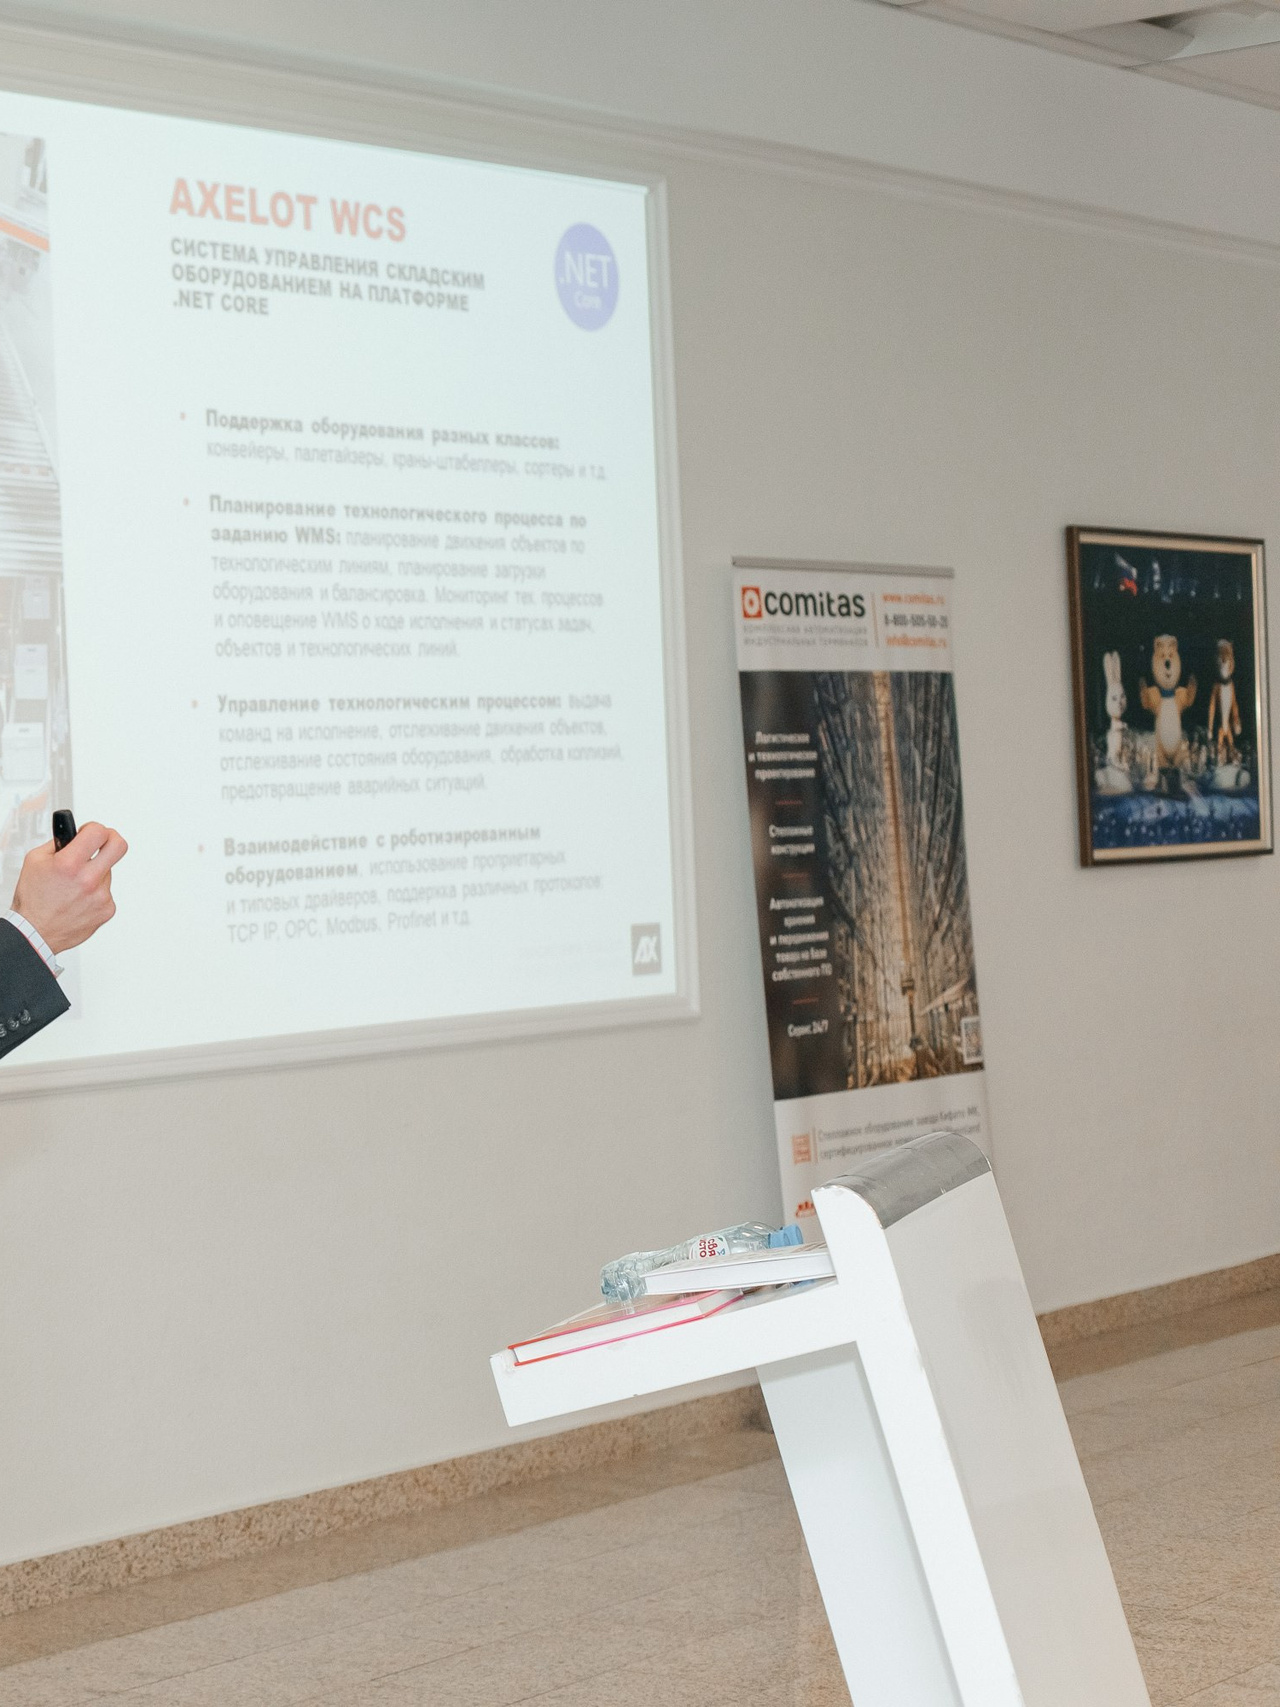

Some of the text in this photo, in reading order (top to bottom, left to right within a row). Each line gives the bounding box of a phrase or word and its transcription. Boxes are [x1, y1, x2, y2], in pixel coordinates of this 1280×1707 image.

[169, 177, 407, 242] AXELOT WCS
[171, 238, 485, 290] СИСТЕМА УПРАВЛЕНИЯ СКЛАДСКИМ
[559, 251, 611, 289] .NET
[171, 263, 469, 311] ОБОРУДОВАНИЕМ НА ПЛАТФОРМЕ
[172, 290, 269, 315] .NET CORE
[206, 409, 560, 450] Поддержка оборудования разных классов:
[209, 494, 586, 530] Планирование технологического процесса по
[211, 527, 288, 545] заданию
[295, 526, 341, 545] WMS:
[765, 591, 866, 617] comitas
[321, 611, 358, 629] WMS
[218, 695, 320, 717] Управление
[329, 696, 470, 711] технологическим
[477, 695, 562, 714] процессом:
[224, 826, 541, 857] Взаимодействие с роботизированным
[228, 923, 258, 943] TCP
